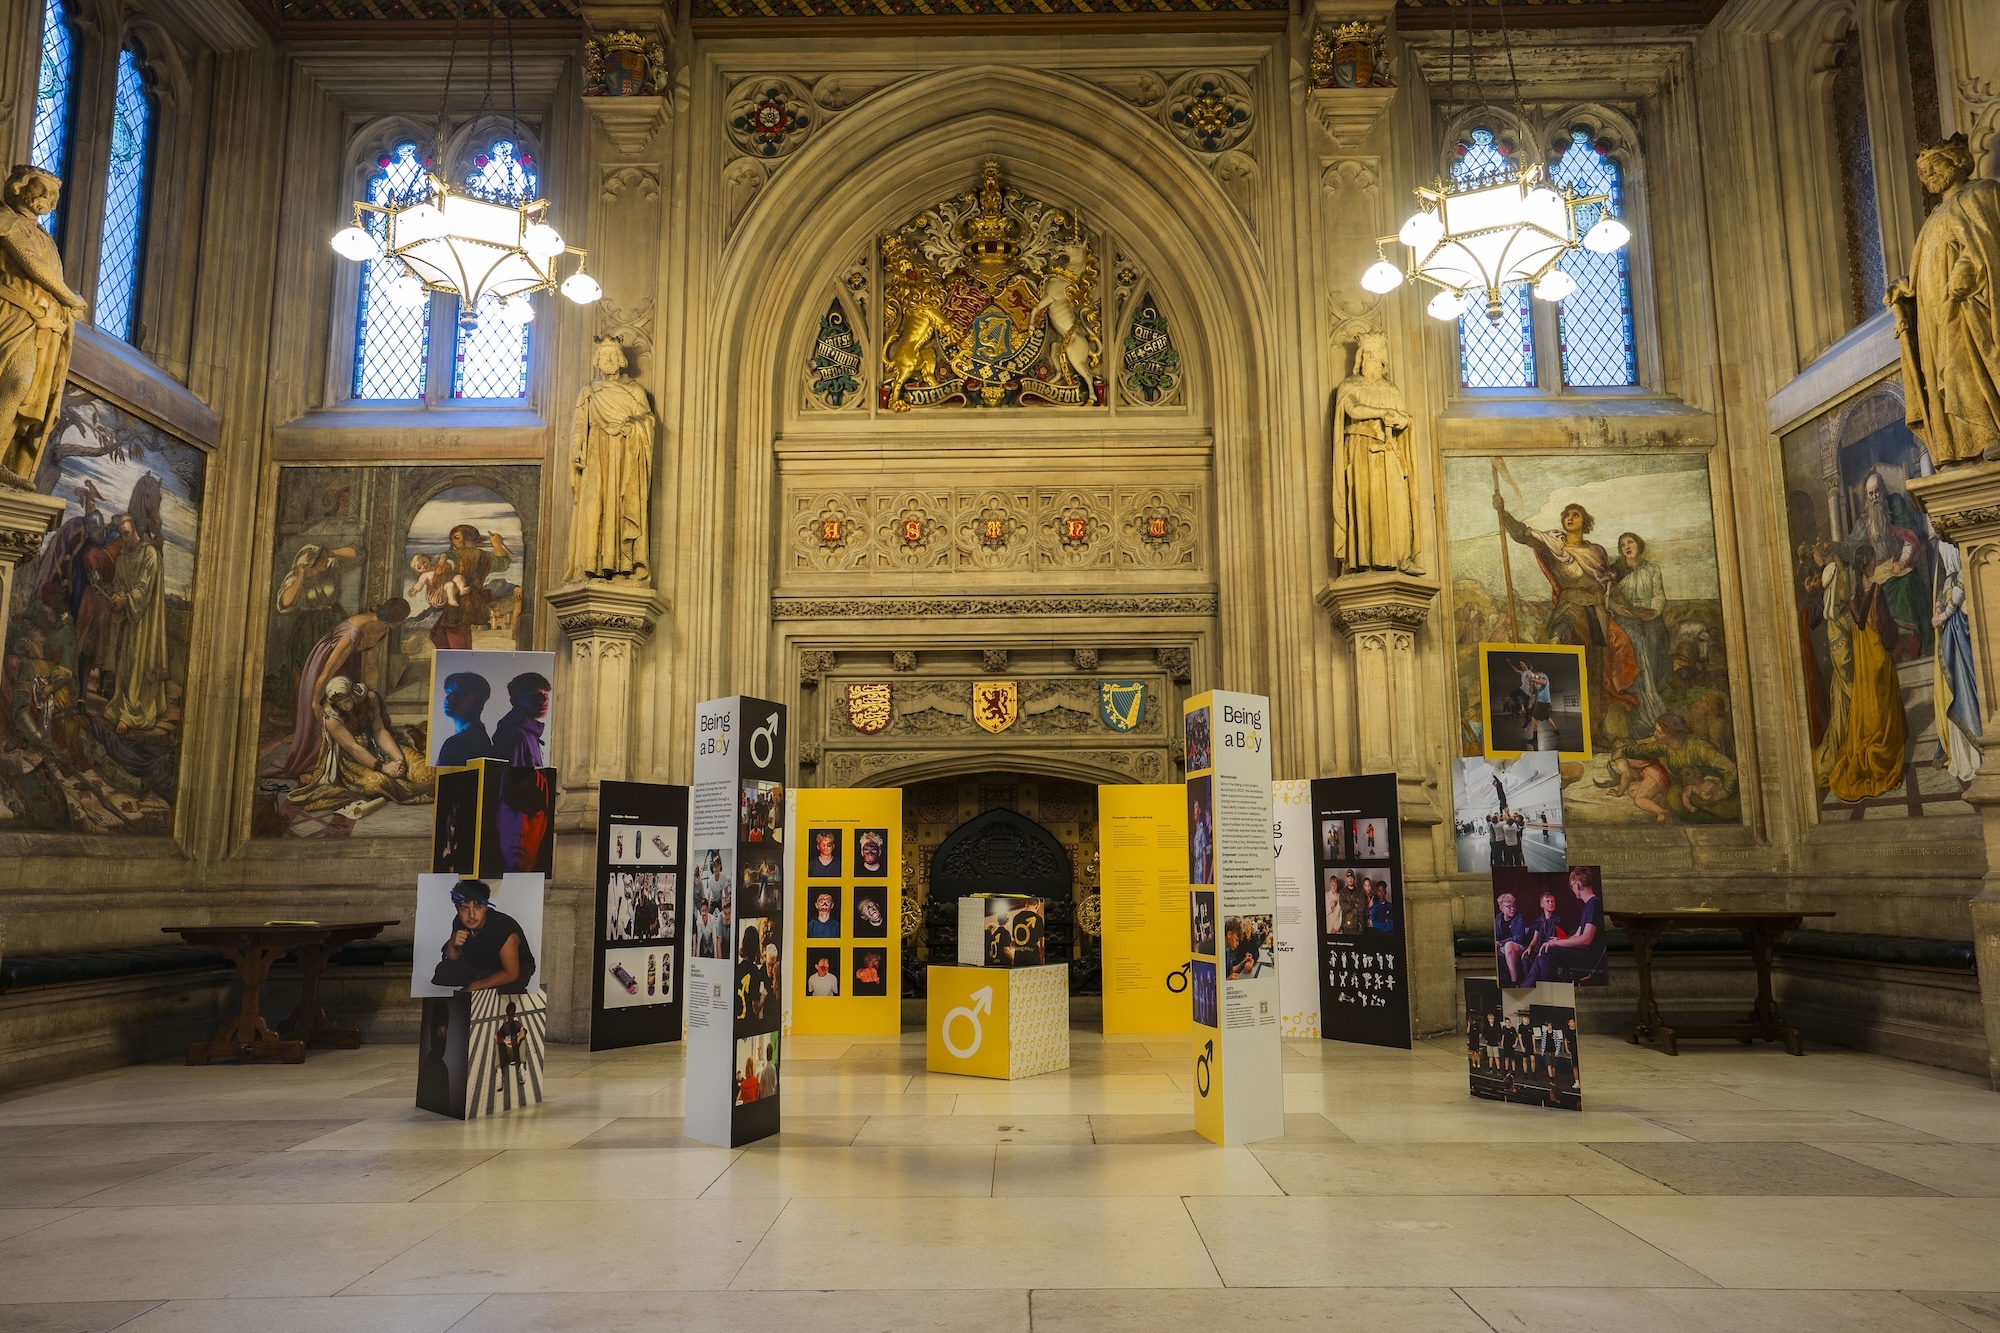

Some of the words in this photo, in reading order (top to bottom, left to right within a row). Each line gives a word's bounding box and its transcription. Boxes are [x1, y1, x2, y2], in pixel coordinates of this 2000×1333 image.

[701, 712, 730, 732] Being
[1224, 706, 1261, 730] Being
[700, 742, 706, 755] a
[708, 735, 730, 756] Boy
[1225, 734, 1234, 747] a
[1236, 731, 1262, 753] Boy
